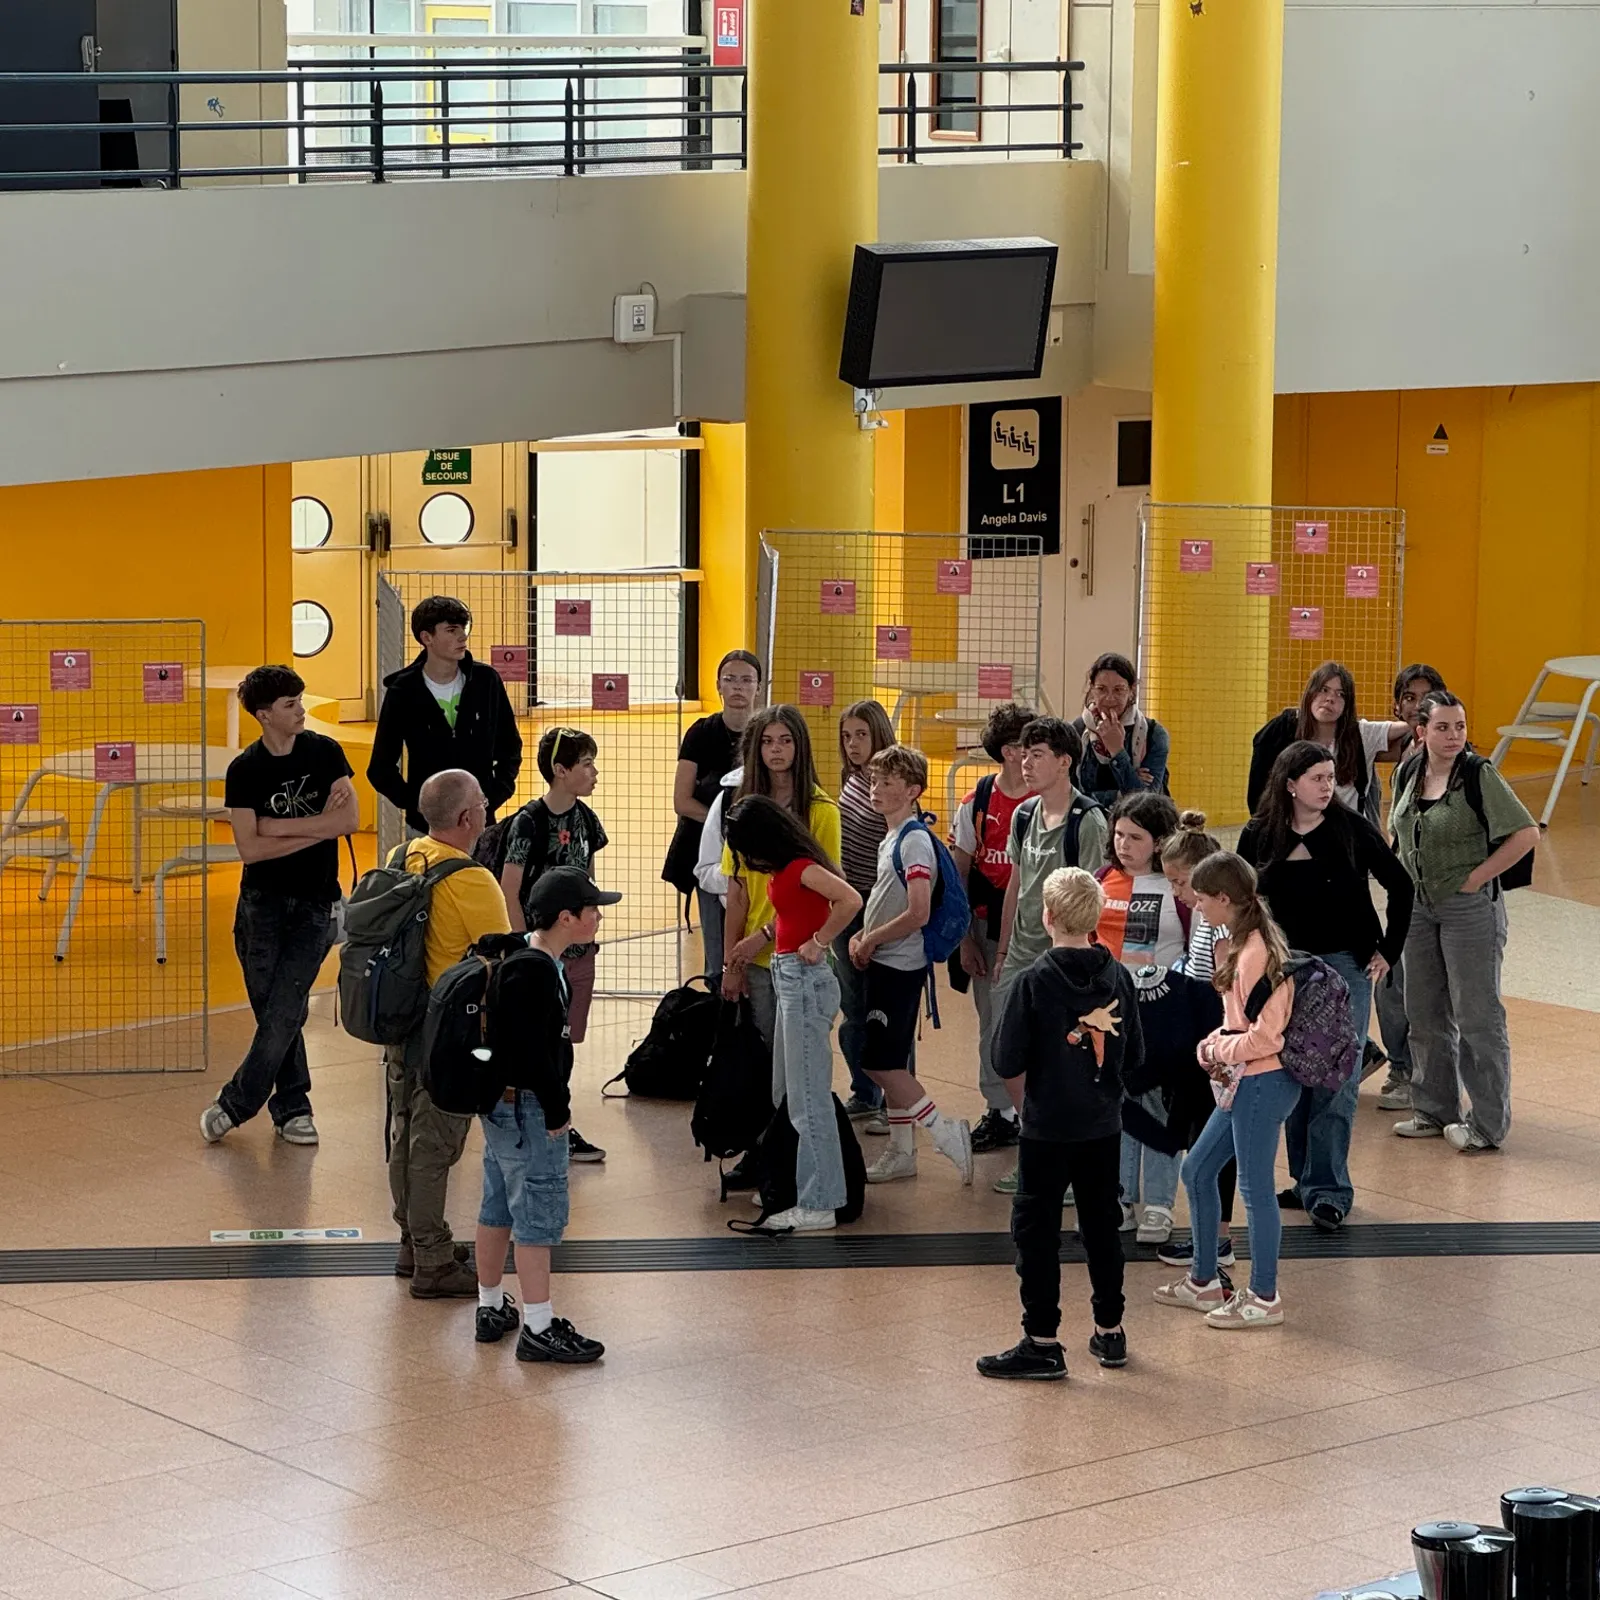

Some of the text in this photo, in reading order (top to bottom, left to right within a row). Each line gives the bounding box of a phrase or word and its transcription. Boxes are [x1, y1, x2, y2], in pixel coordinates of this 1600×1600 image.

[433, 452, 460, 460] ISSUE
[440, 462, 453, 470] DE
[425, 471, 469, 481] SECOURS
[1003, 482, 1024, 503] L1
[980, 511, 1047, 527] Angela Davis
